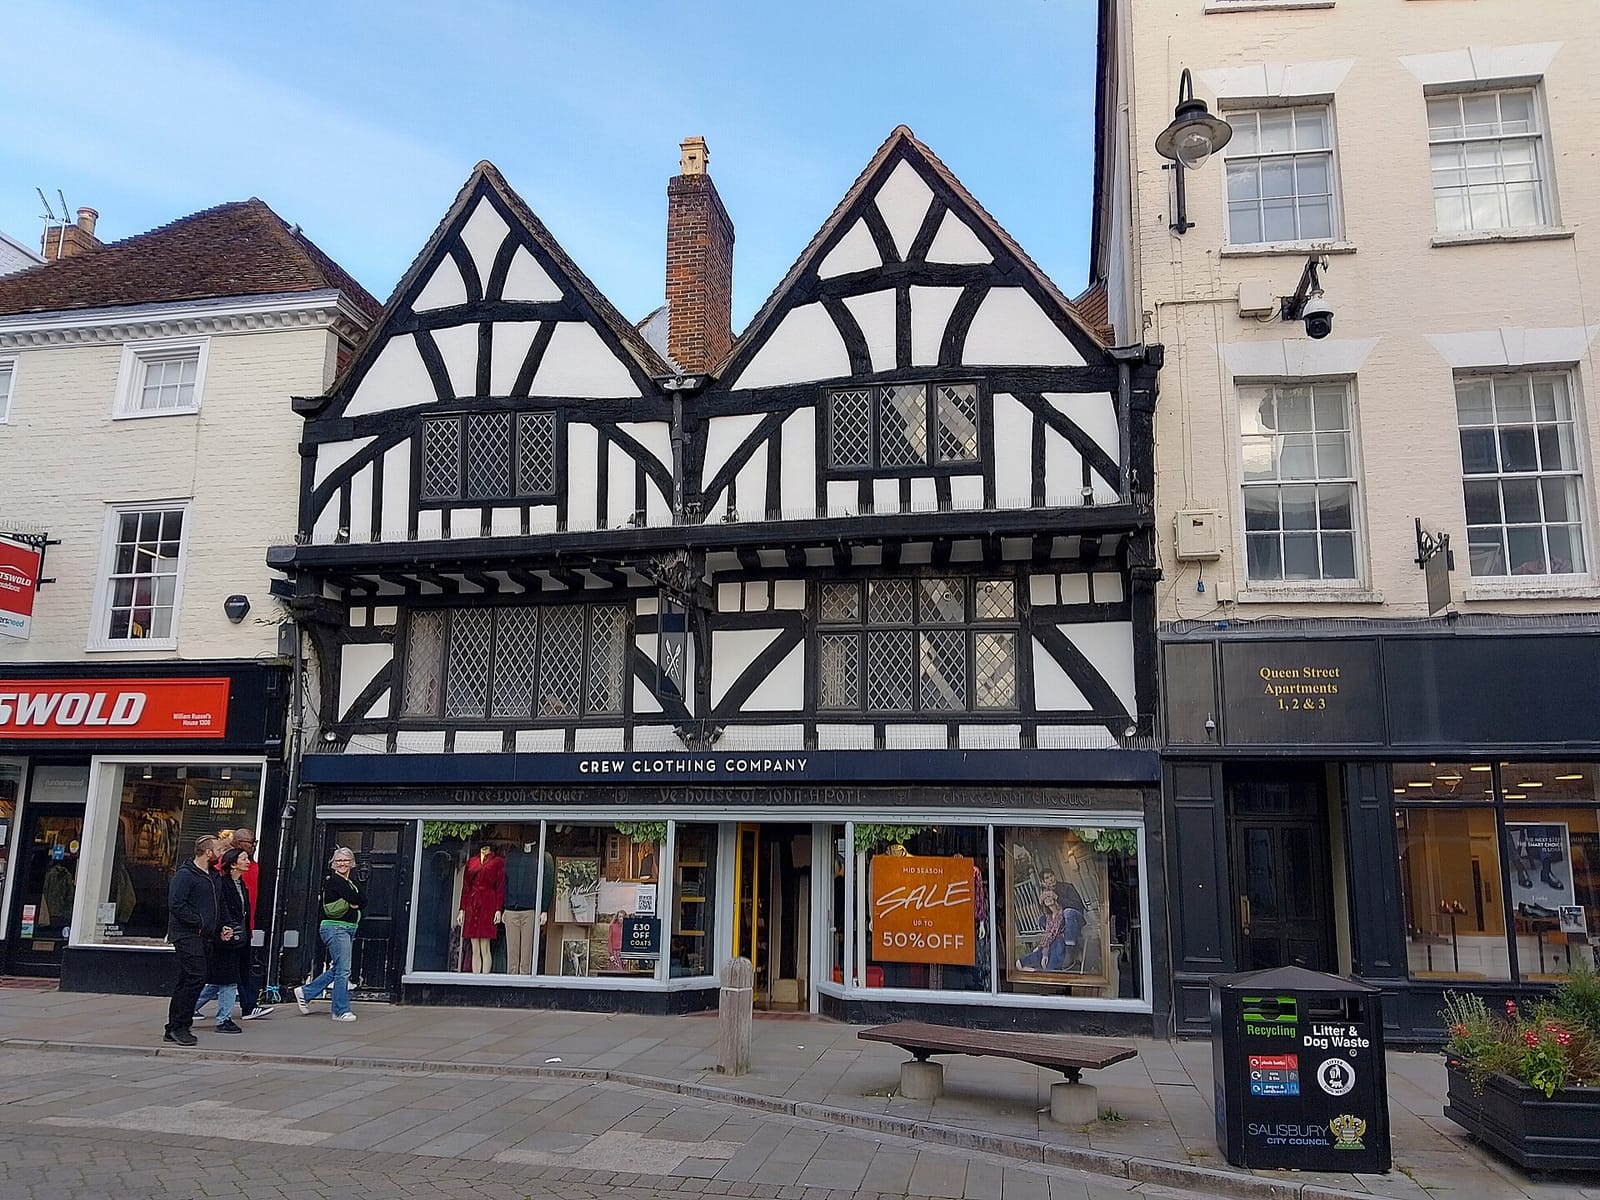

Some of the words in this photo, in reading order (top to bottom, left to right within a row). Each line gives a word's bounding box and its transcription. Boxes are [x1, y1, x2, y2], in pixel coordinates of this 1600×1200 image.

[1260, 667, 1299, 680] Queen
[1303, 667, 1340, 678] Street
[1264, 683, 1338, 696] Apartments
[1279, 698, 1289, 711] 1,
[1292, 698, 1299, 709] 2
[1303, 698, 1315, 709] &
[1318, 698, 1326, 709] 3
[579, 761, 625, 773] CREW
[632, 759, 716, 773] CLOTHING
[725, 758, 807, 772] COMPANY
[211, 797, 219, 808] TO
[219, 797, 234, 808] RUN
[876, 880, 971, 919] SALE
[633, 923, 650, 931] £30
[632, 931, 650, 939] OFF
[1247, 1025, 1296, 1038] Recycling
[1313, 1025, 1345, 1036] Litter
[1348, 1025, 1358, 1036] &
[1303, 1036, 1328, 1049] Dog
[1331, 1036, 1370, 1048] Waste
[1248, 1123, 1329, 1137] SALISBURY
[1288, 1138, 1330, 1146] COUNCIL
